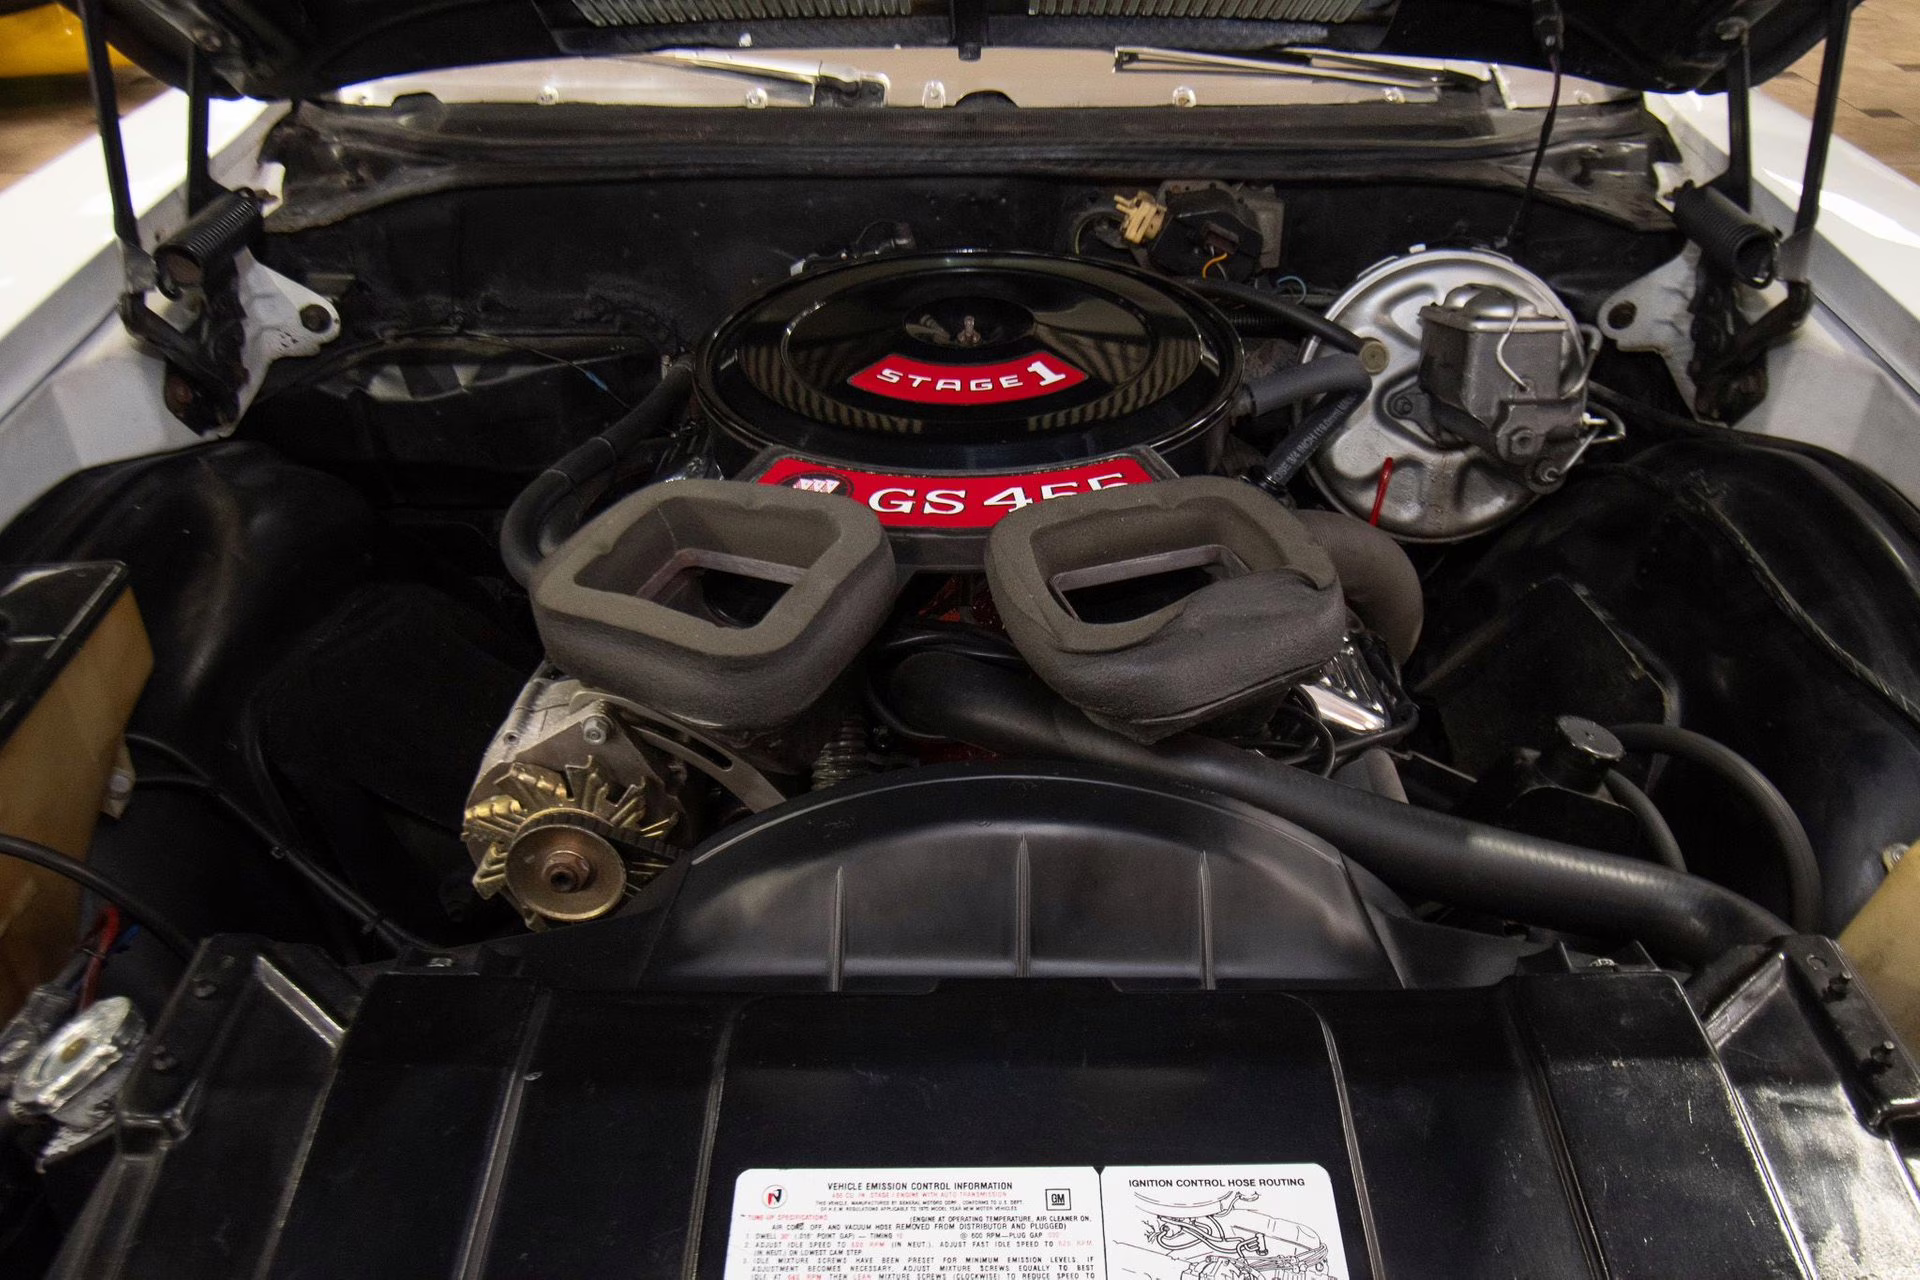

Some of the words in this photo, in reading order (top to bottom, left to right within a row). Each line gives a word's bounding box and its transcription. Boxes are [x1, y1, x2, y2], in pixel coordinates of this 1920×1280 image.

[876, 368, 1023, 391] STAGE
[1026, 360, 1066, 387] 1
[868, 488, 966, 515] GS
[911, 1182, 950, 1190] CONTROL
[1128, 1179, 1173, 1187] IGNITION
[1176, 1179, 1225, 1187] CONTROL
[1228, 1179, 1256, 1187] HOSE
[1259, 1178, 1305, 1187] ROUTING
[1051, 1193, 1065, 1204] GM
